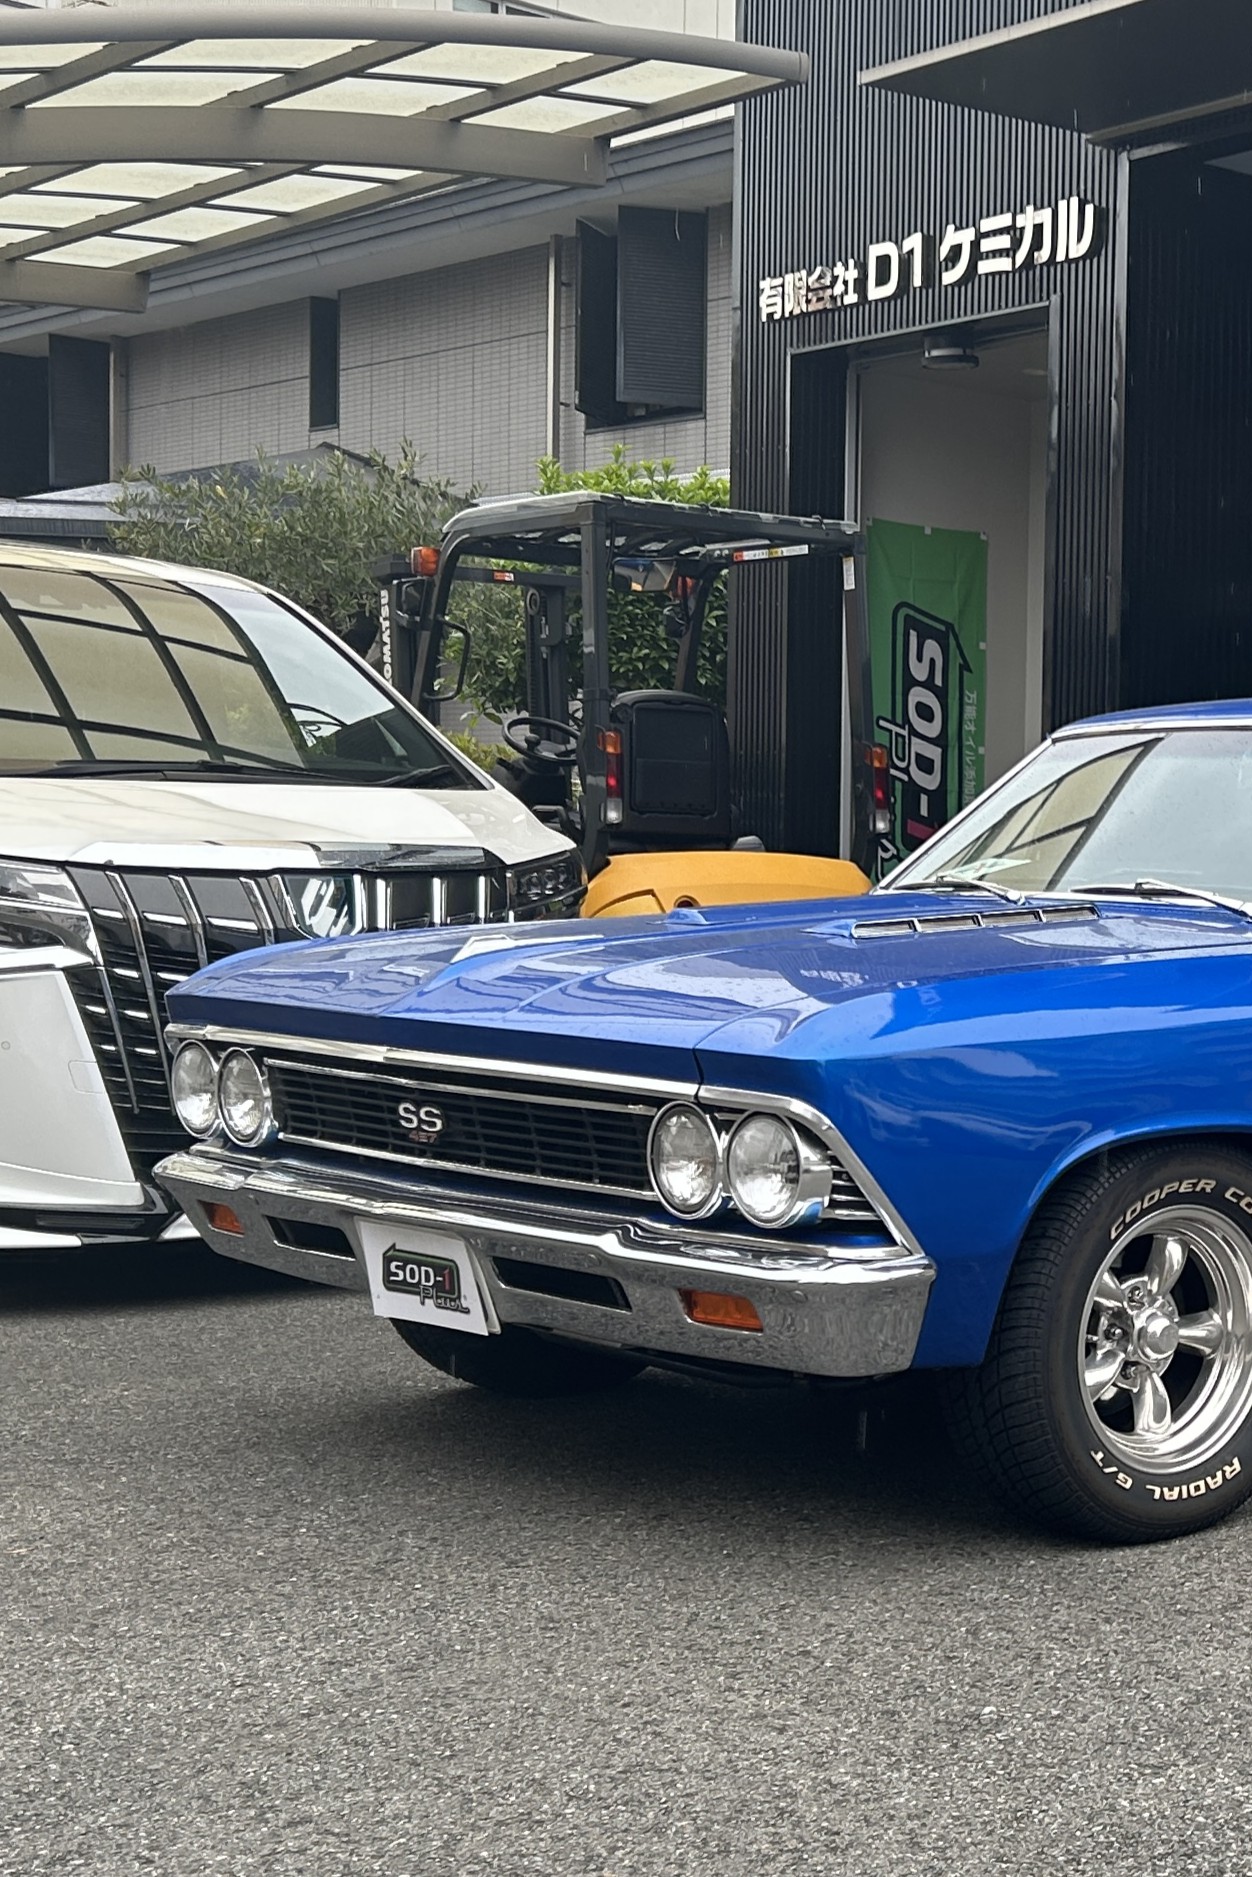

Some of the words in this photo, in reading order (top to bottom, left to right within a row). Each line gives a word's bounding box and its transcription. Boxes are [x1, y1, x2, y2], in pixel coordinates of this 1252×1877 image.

[398, 1102, 443, 1131] SS
[1110, 1178, 1217, 1241] COOPER
[389, 1261, 451, 1291] SOD-1
[1146, 1455, 1243, 1502] RADIAL
